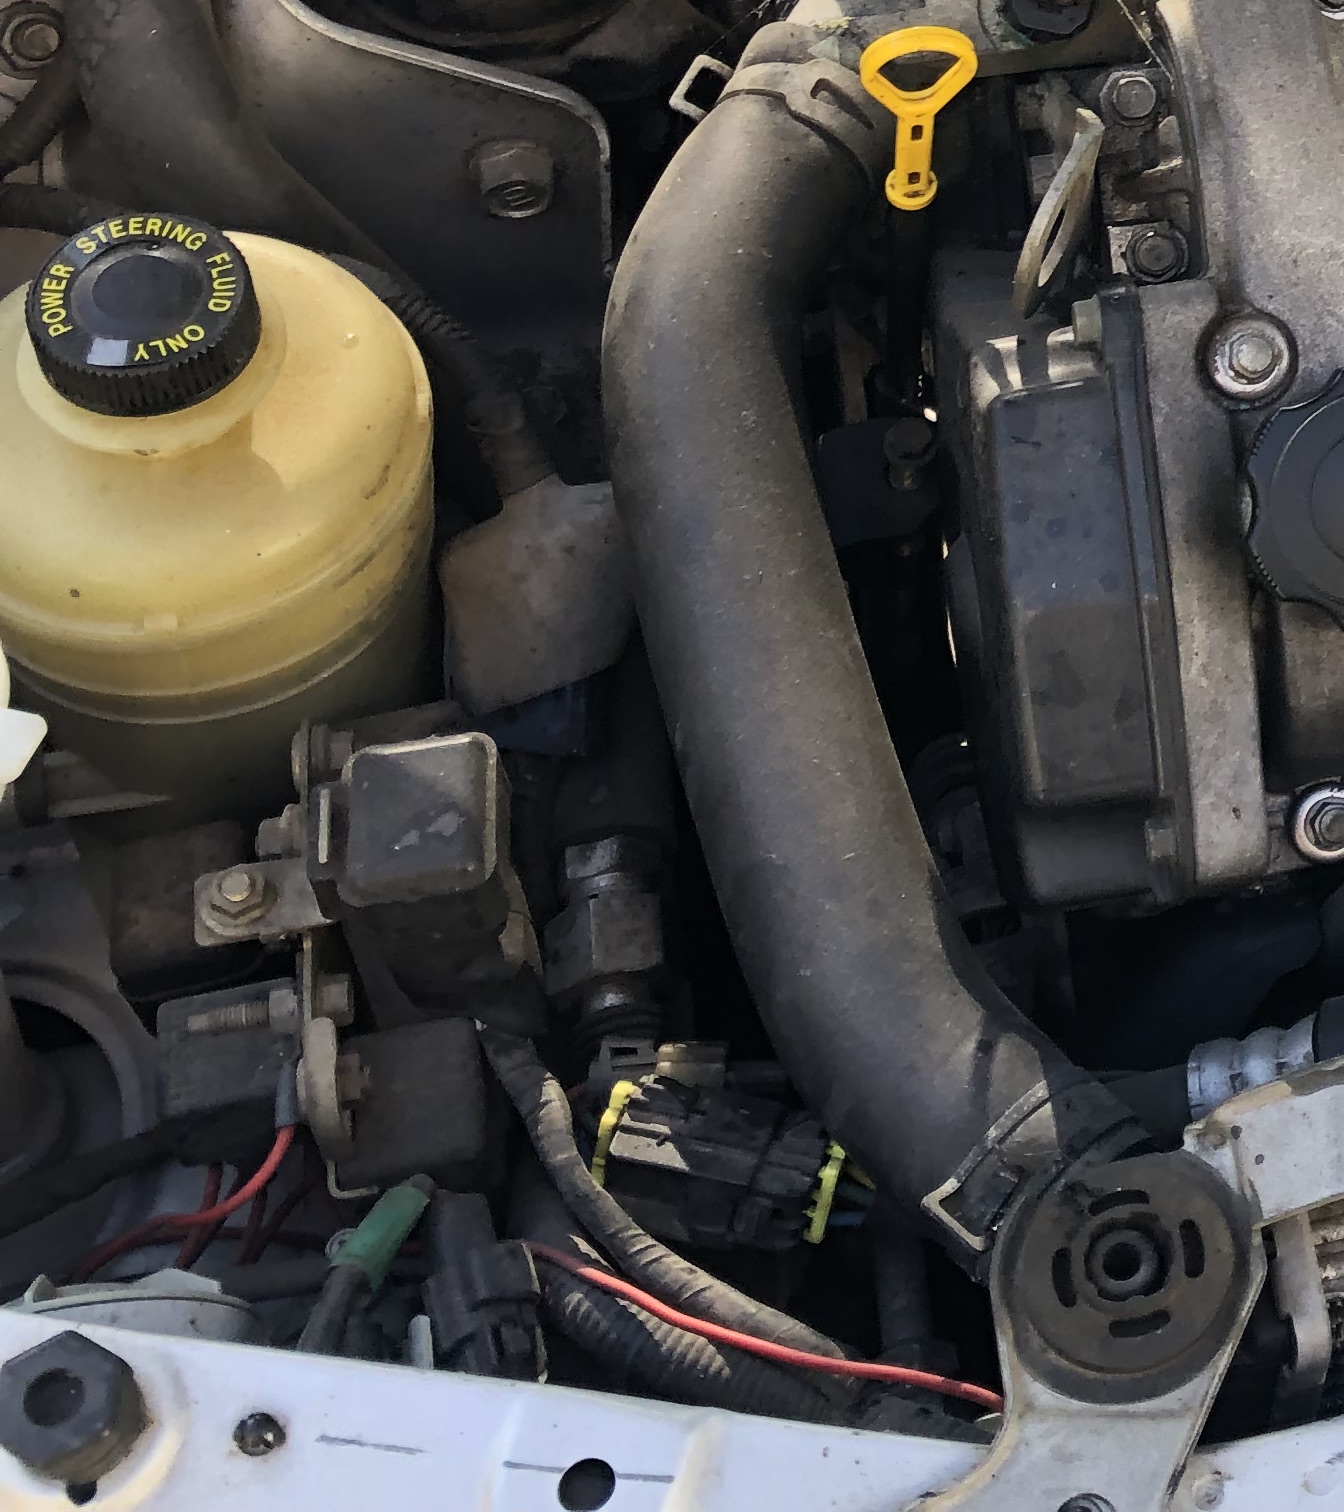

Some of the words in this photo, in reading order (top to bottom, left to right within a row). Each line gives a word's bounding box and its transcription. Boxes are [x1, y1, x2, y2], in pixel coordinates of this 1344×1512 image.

[75, 216, 208, 255] STEERING
[40, 263, 75, 338] POWER
[205, 251, 237, 313] FLUID
[133, 323, 206, 362] ONLY
